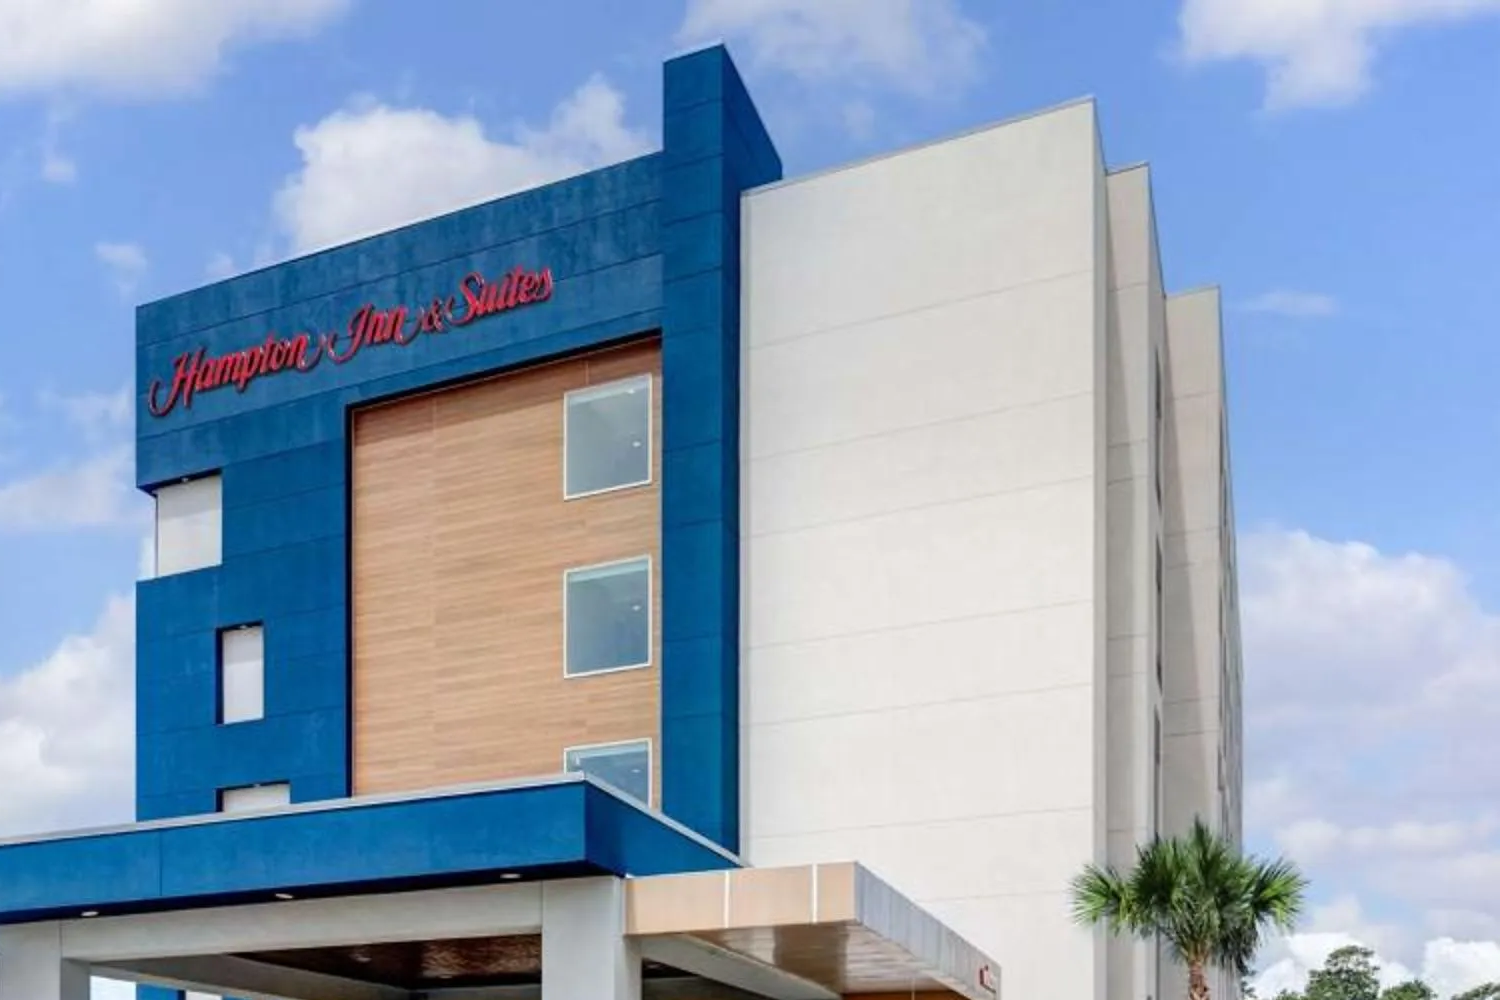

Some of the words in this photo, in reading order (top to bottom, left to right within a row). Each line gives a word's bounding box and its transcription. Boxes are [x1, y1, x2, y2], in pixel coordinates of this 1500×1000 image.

[148, 332, 328, 416] Hampton
[327, 302, 424, 364] Inn
[421, 299, 443, 332] &
[444, 267, 554, 326] Suites
